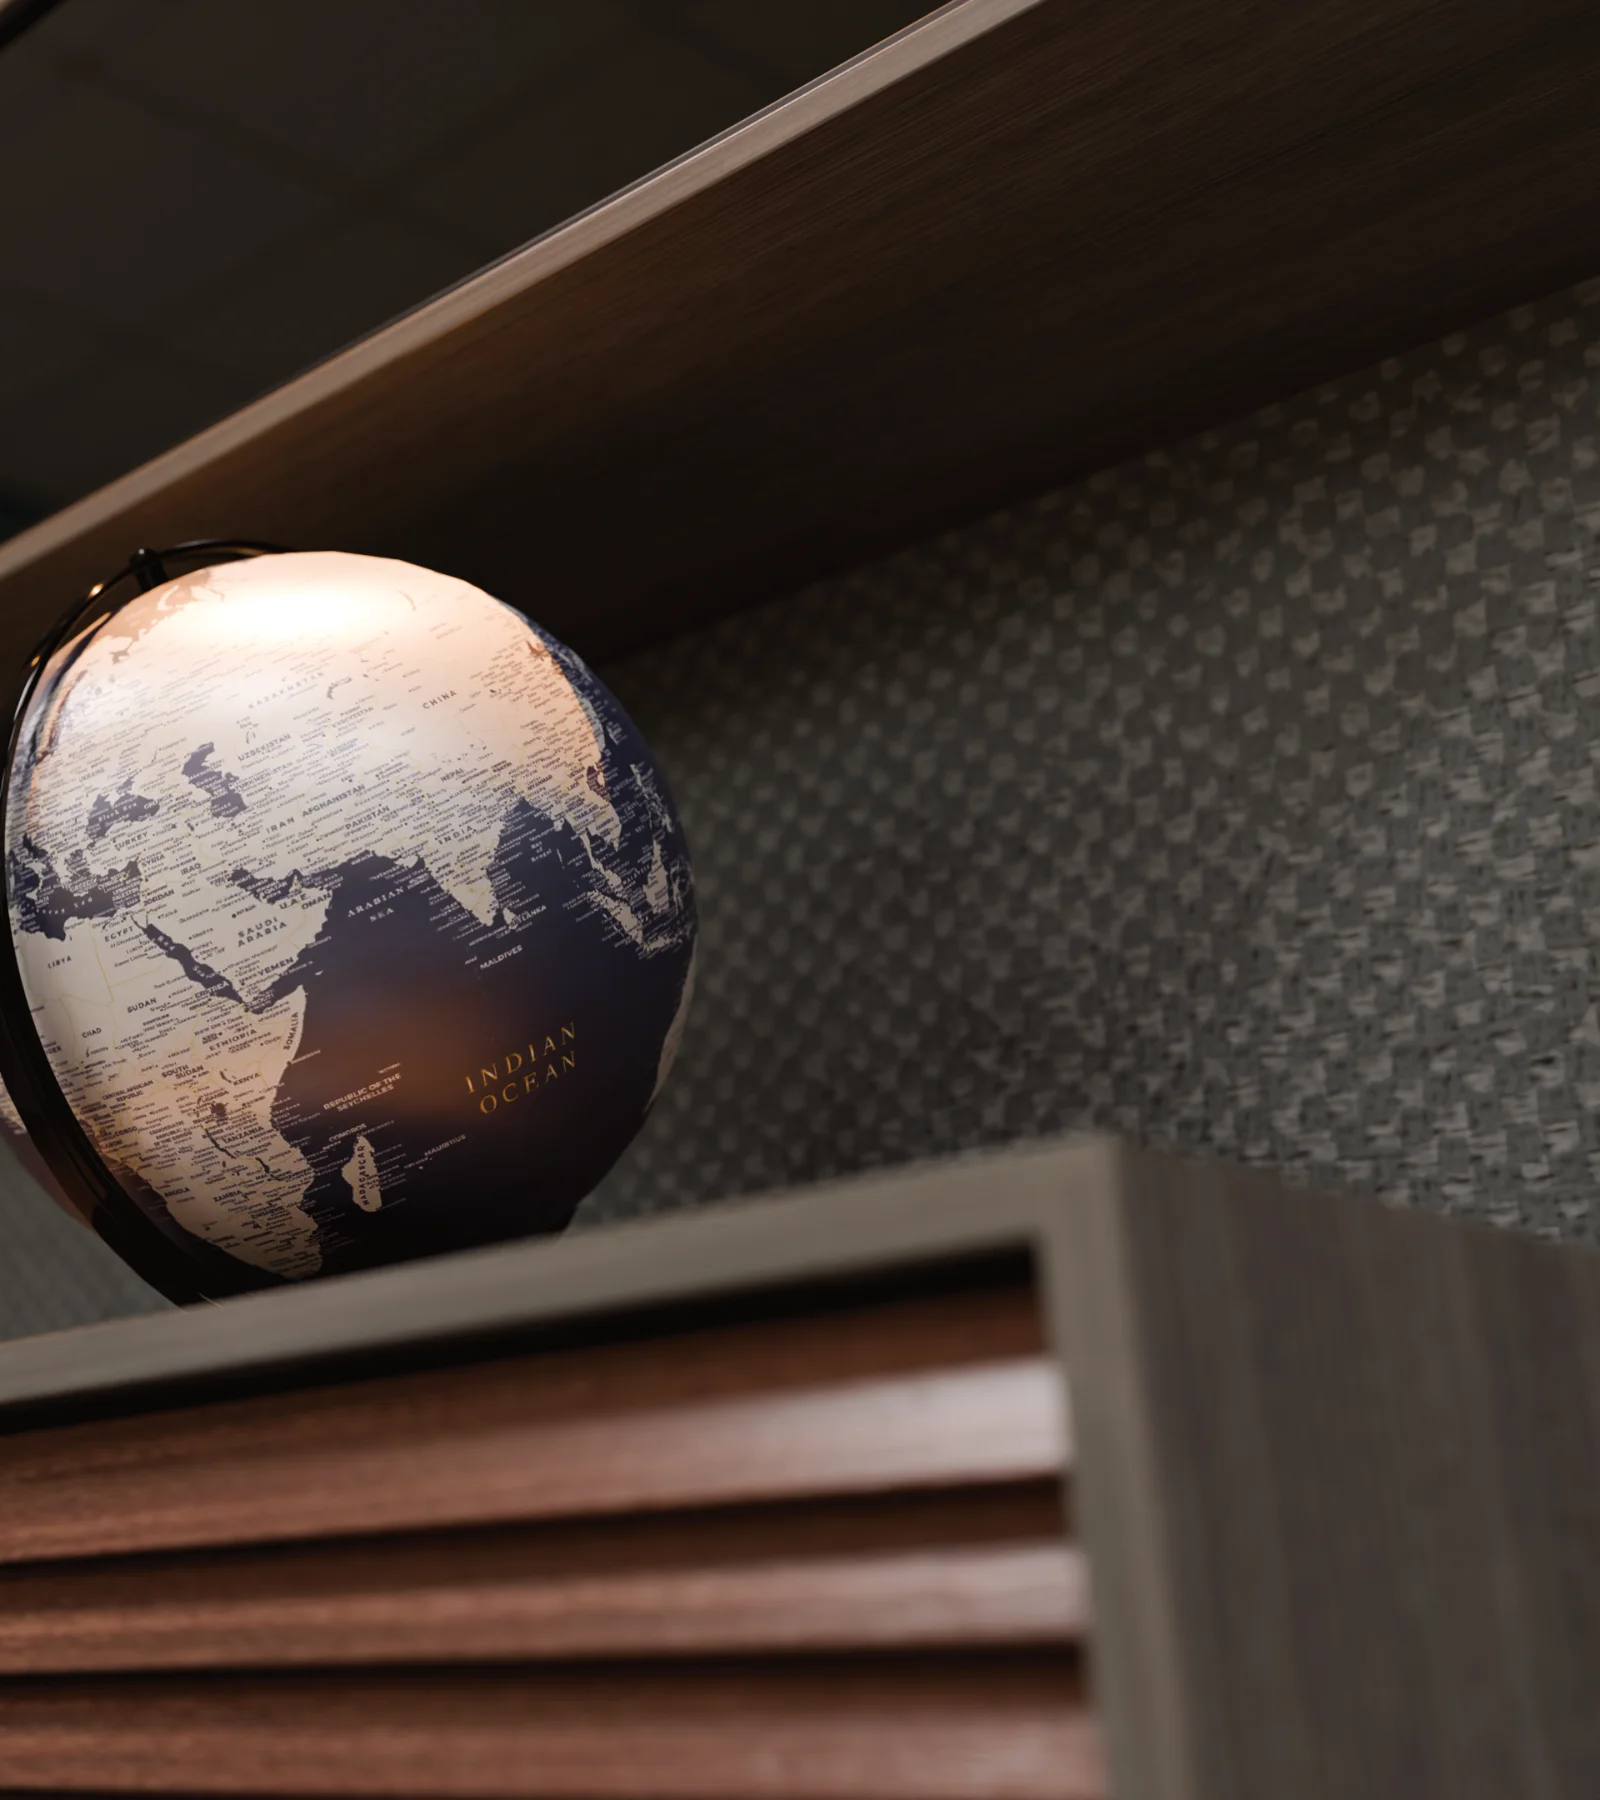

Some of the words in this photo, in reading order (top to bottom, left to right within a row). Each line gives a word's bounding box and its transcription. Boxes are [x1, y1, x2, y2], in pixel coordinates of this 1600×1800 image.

[422, 690, 457, 709] CHINA
[238, 733, 292, 761] UZBEKISTAN
[440, 768, 465, 782] NEPAL
[527, 774, 553, 790] MYANMAR
[302, 784, 366, 817] AFGHANISTAN
[266, 817, 295, 834] IRAN
[345, 805, 390, 830] PAKISTAN
[113, 831, 148, 851] TURKEY
[438, 825, 473, 846] INDIA
[141, 853, 165, 868] SYRIA
[180, 862, 201, 875] IRAQ
[143, 889, 175, 906] JORDAN
[264, 881, 288, 895] QATAR
[301, 892, 331, 910] OMAN
[347, 886, 405, 918] ARABIAN
[104, 926, 134, 942] EGYPT
[238, 916, 278, 938] SAUDI
[238, 921, 287, 947] ARABIA
[47, 955, 72, 969] LIBYA
[480, 944, 523, 970] MALDIVES
[258, 957, 294, 978] YEMEN
[127, 997, 157, 1013] SUDAN
[82, 1027, 102, 1039] CHAD
[209, 1029, 257, 1051] ETHIOPIA
[283, 1012, 299, 1051] SOMALIA
[465, 1021, 575, 1094] INDIAN
[161, 1064, 189, 1078] SOUTH
[175, 1065, 204, 1079] SUDAN
[233, 1072, 260, 1086] KENYA
[323, 1086, 368, 1110] REPUBLIC
[368, 1081, 382, 1092] OF
[383, 1073, 402, 1085] THE
[480, 1051, 575, 1114] OCEAN
[336, 1084, 394, 1112] SEYCHELLES
[223, 1126, 264, 1144] TANZANIA
[329, 1123, 367, 1142] COMOROS
[424, 1134, 466, 1156] MAURITIUS
[359, 1145, 370, 1206] MADAGASCAR
[213, 1189, 243, 1202] ZAMBIA
